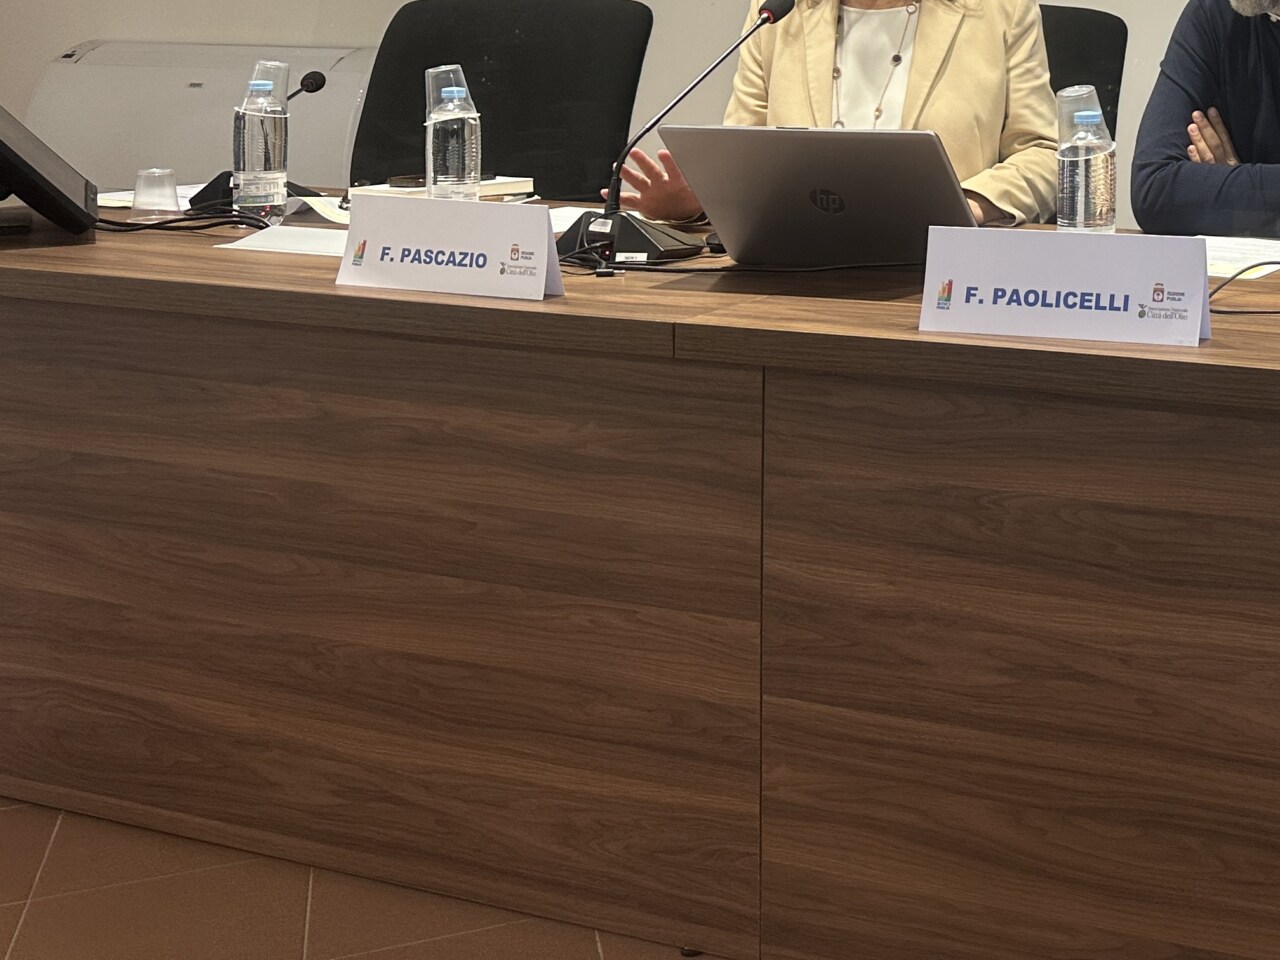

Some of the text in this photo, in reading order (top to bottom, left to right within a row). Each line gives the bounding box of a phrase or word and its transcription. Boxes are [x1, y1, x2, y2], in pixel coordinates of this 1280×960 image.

[380, 246, 488, 268] F. PASCAZIO
[965, 286, 1130, 312] F. PAOLICELLI
[1147, 311, 1161, 319] Città
